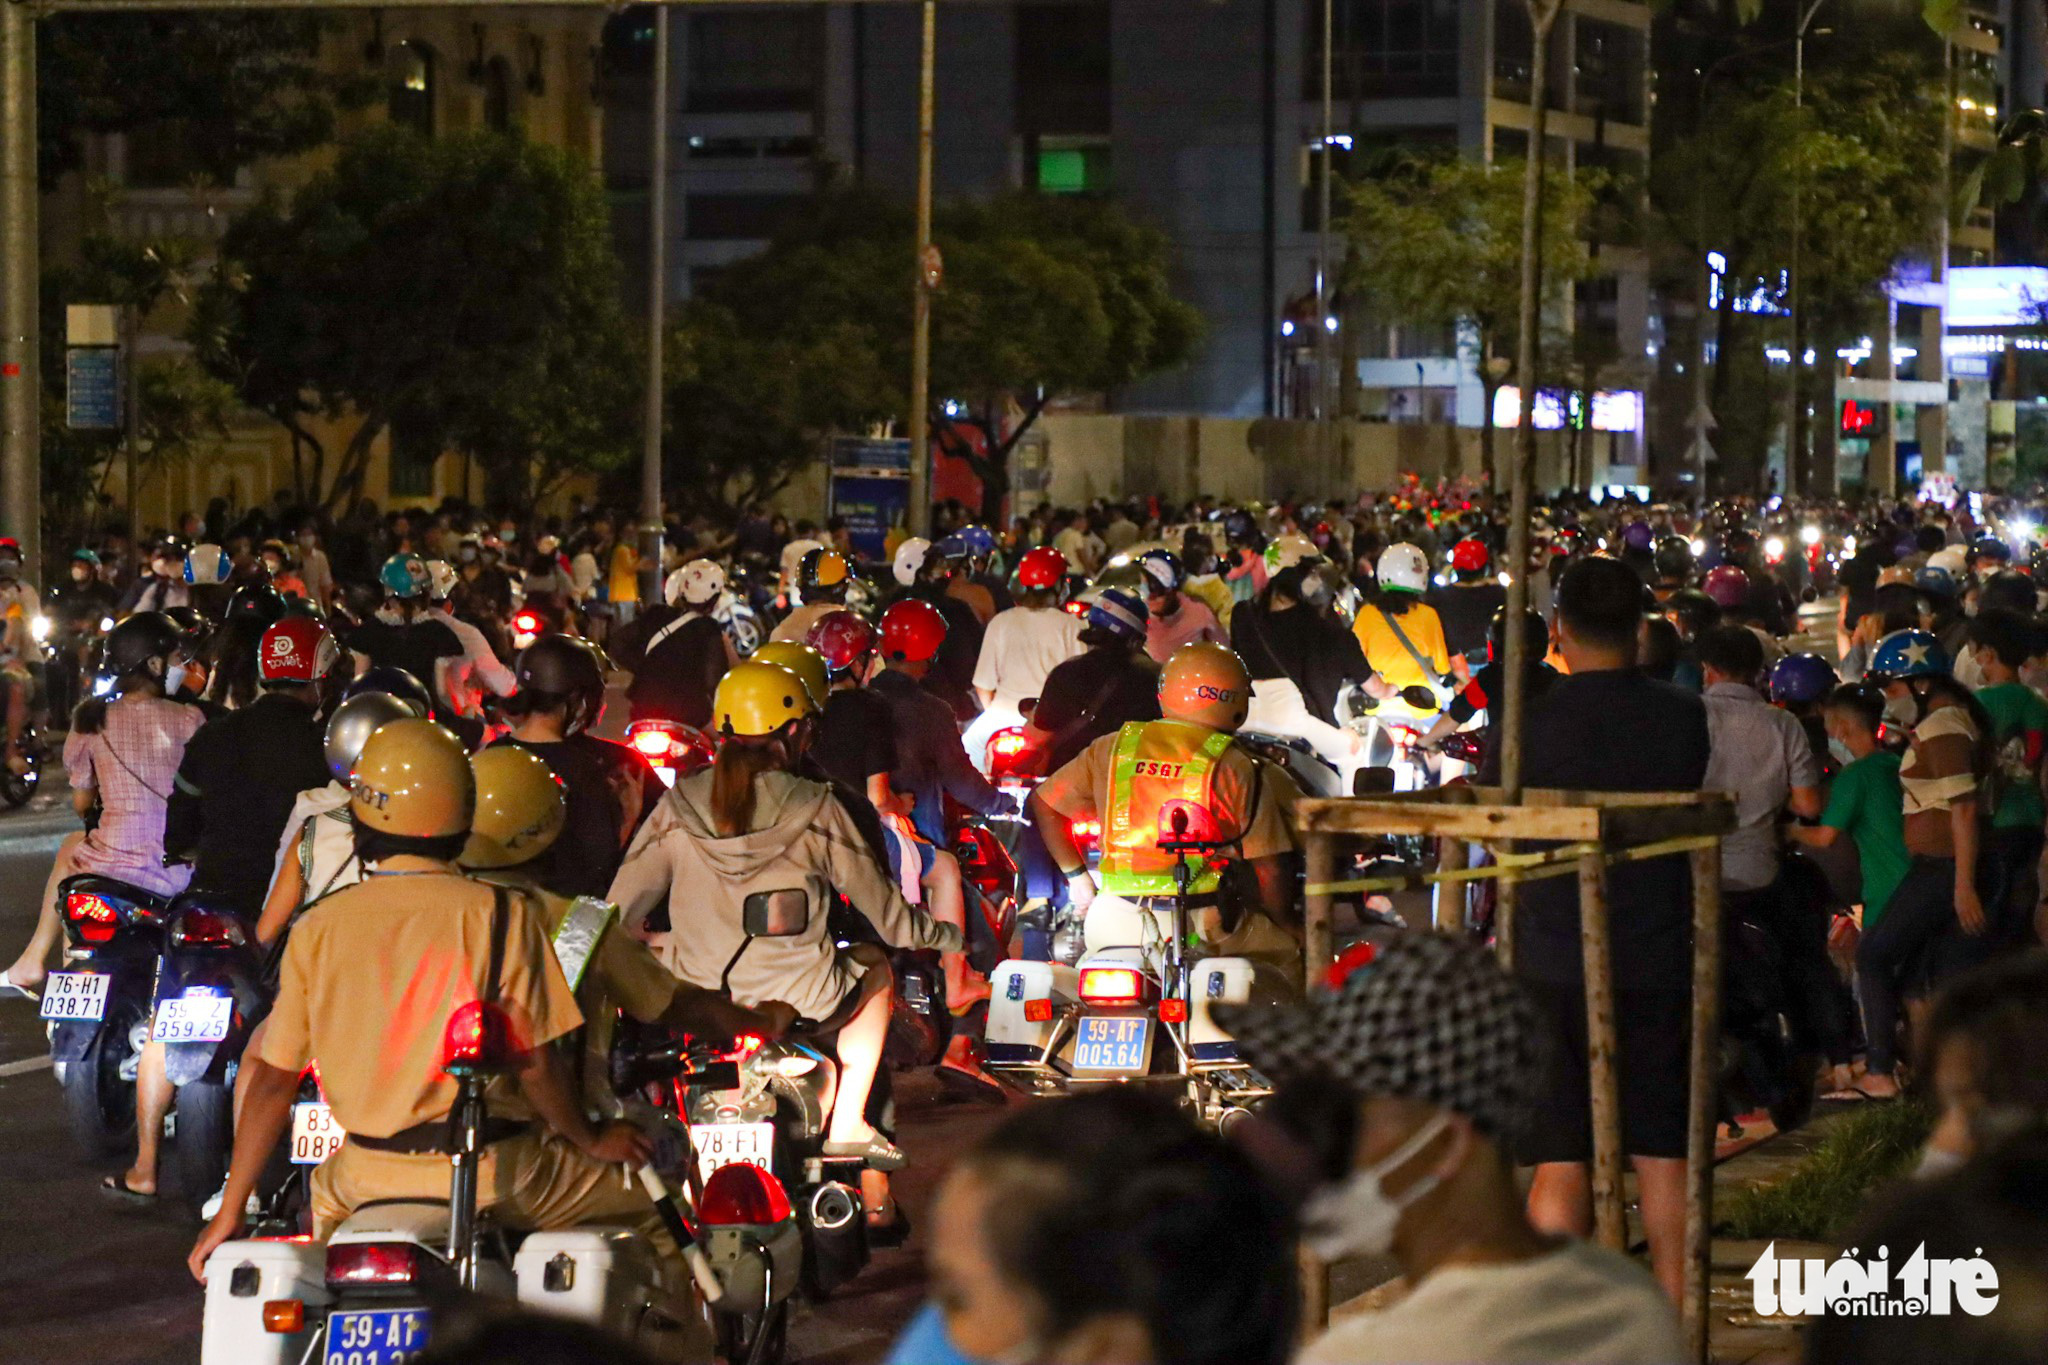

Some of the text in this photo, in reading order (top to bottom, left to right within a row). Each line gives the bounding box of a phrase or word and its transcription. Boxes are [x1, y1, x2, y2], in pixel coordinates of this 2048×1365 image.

[1135, 761, 1183, 778] CSGT
[56, 975, 100, 995] 76-H1
[44, 998, 102, 1016] 038.71
[157, 1020, 225, 1038] 359.25
[1078, 1043, 1139, 1066] 005.64
[701, 1130, 757, 1154] 78-F1
